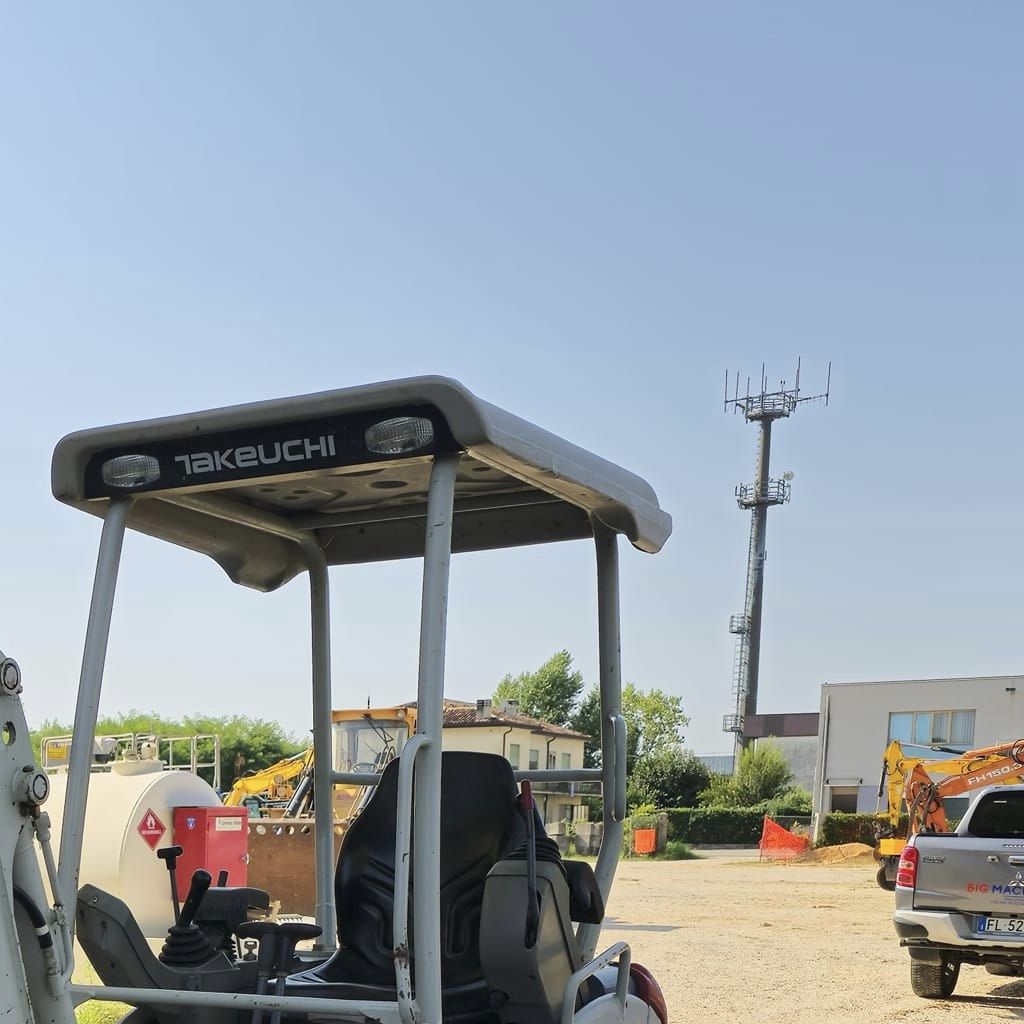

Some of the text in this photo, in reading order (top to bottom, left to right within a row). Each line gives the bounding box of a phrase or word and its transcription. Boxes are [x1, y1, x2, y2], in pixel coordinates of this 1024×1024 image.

[175, 434, 336, 475] TAKEUCHI
[966, 883, 989, 893] BIG
[986, 919, 1002, 931] FL
